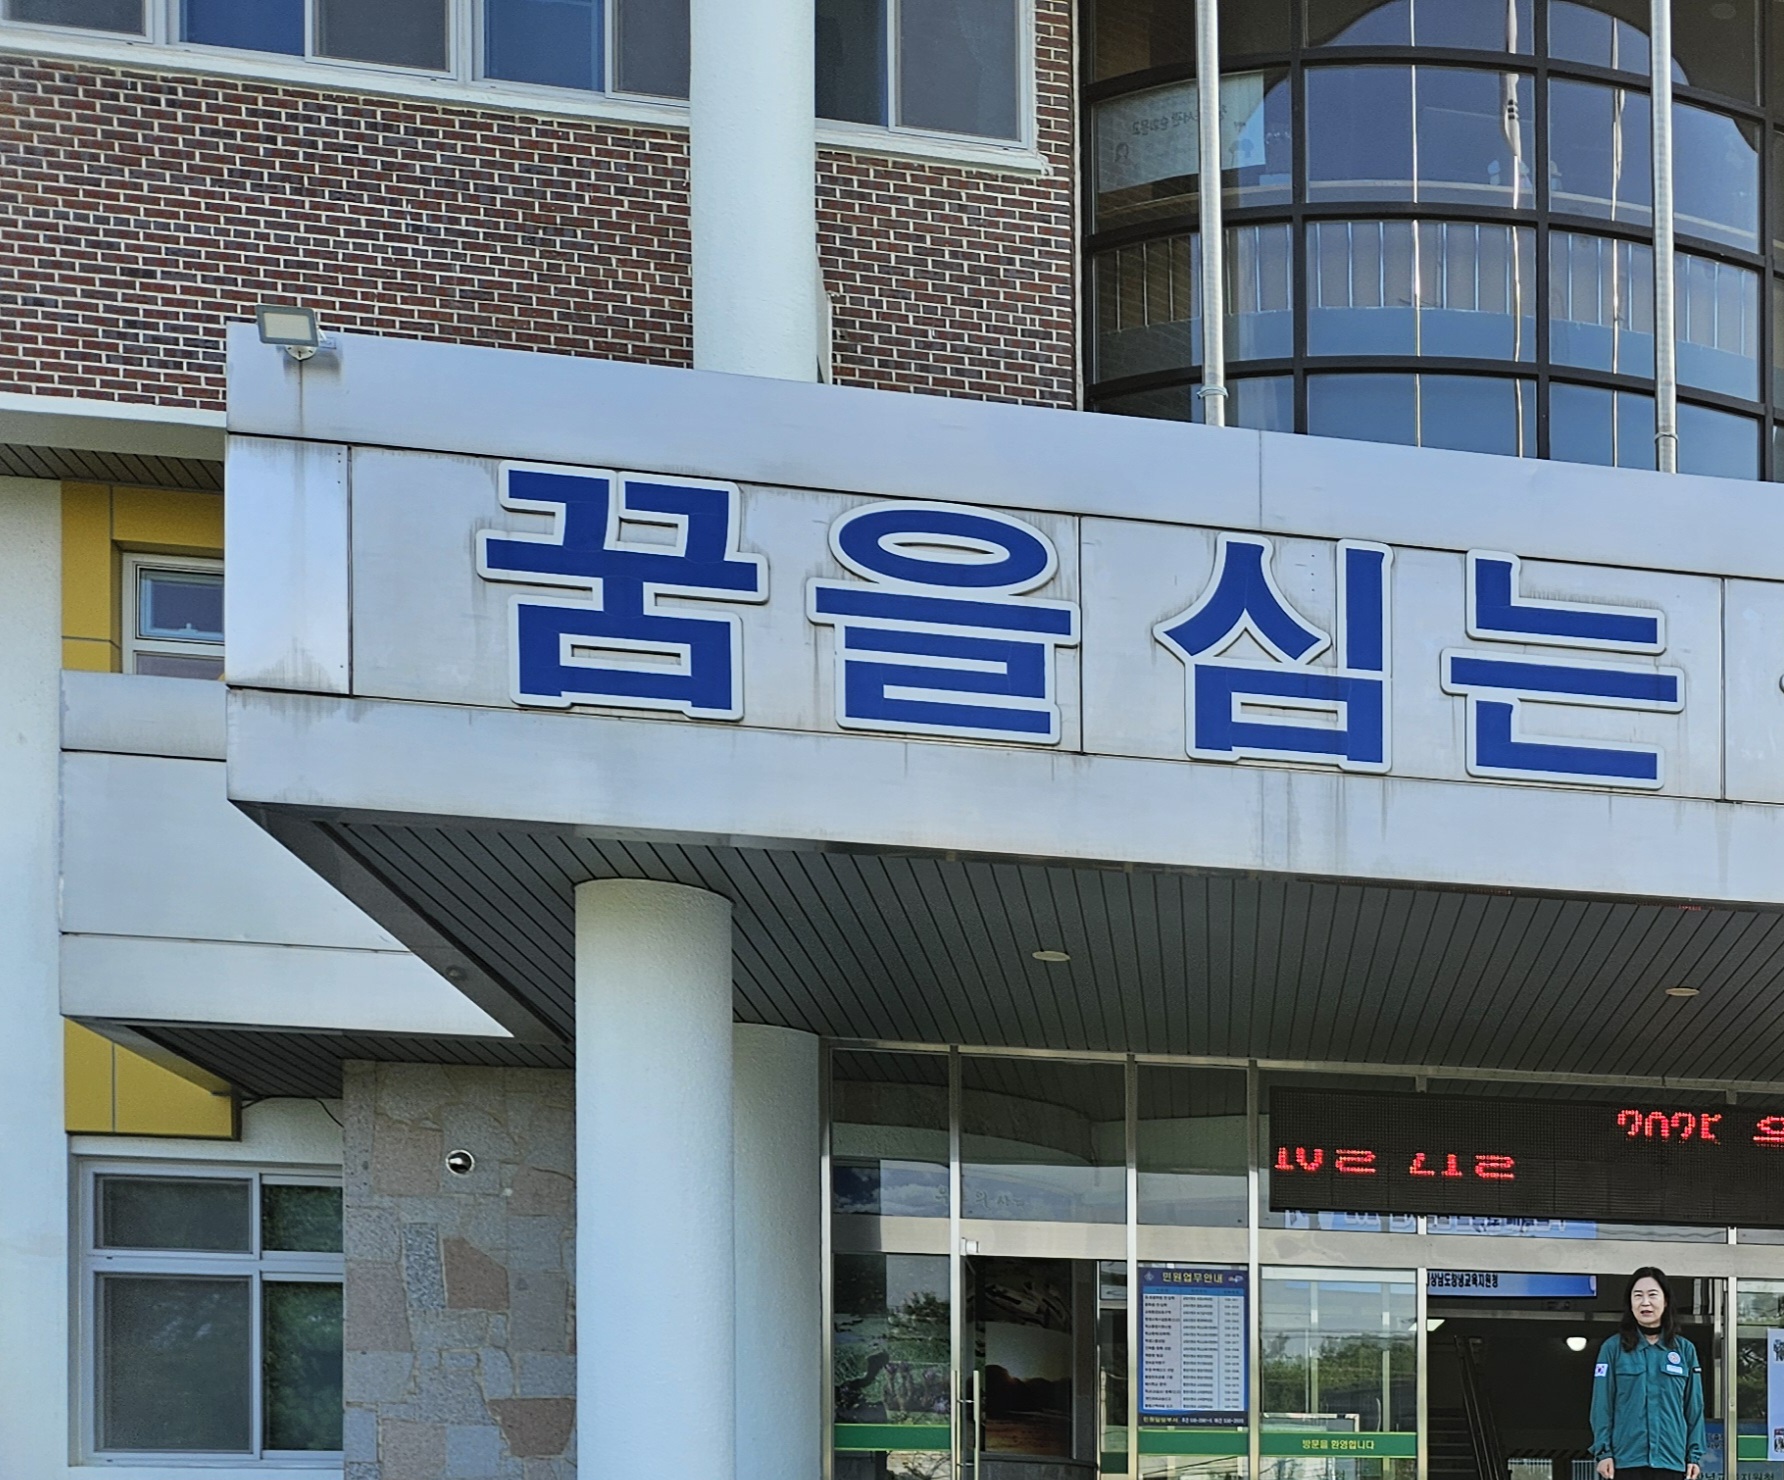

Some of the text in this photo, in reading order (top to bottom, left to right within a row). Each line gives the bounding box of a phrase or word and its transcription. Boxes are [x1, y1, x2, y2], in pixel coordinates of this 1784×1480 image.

[481, 466, 1075, 740] 꿈을
[1160, 537, 1681, 784] 심는
[1162, 1272, 1223, 1283] 민원업무안내
[1427, 1272, 1498, 1288] 상남도창녕교육지원청
[1302, 1439, 1375, 1450] 방문을 환영합니다
